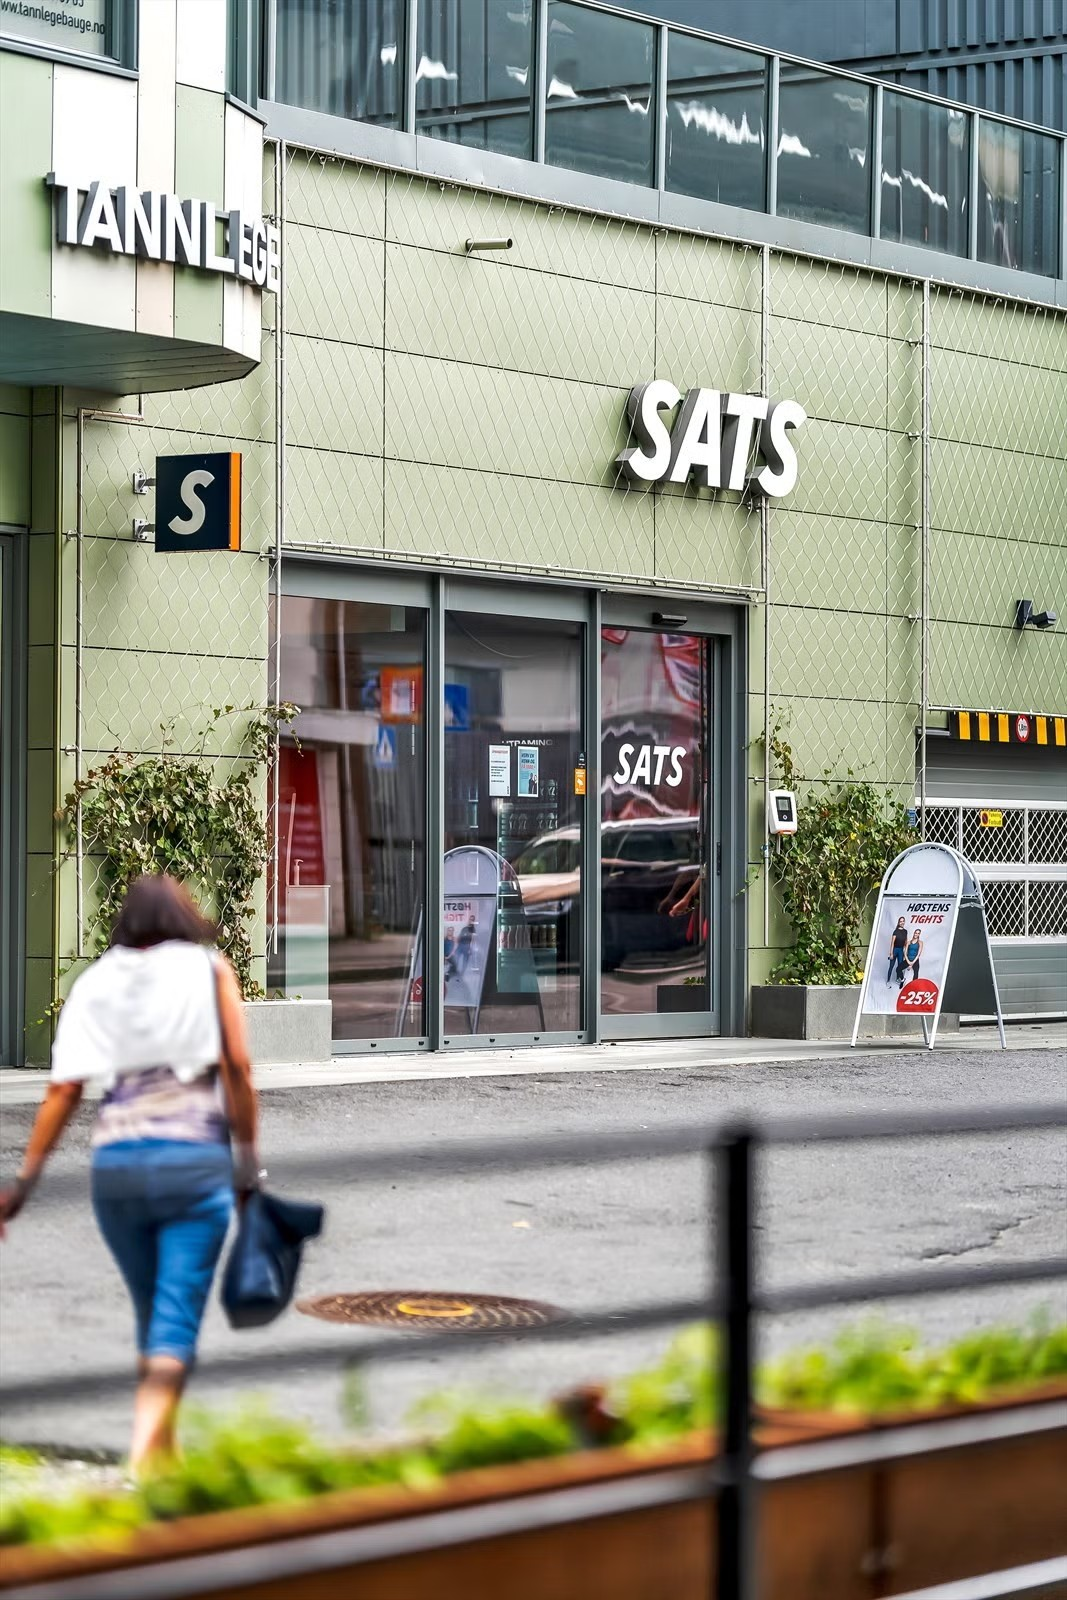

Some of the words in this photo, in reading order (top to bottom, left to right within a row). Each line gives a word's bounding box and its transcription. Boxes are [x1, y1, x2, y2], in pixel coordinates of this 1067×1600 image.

[617, 379, 808, 498] SATS
[167, 469, 216, 535] S
[612, 743, 687, 787] SATS
[907, 903, 951, 912] HØSTENS
[910, 914, 944, 924] TIGHTS
[900, 990, 937, 1006] -25%
